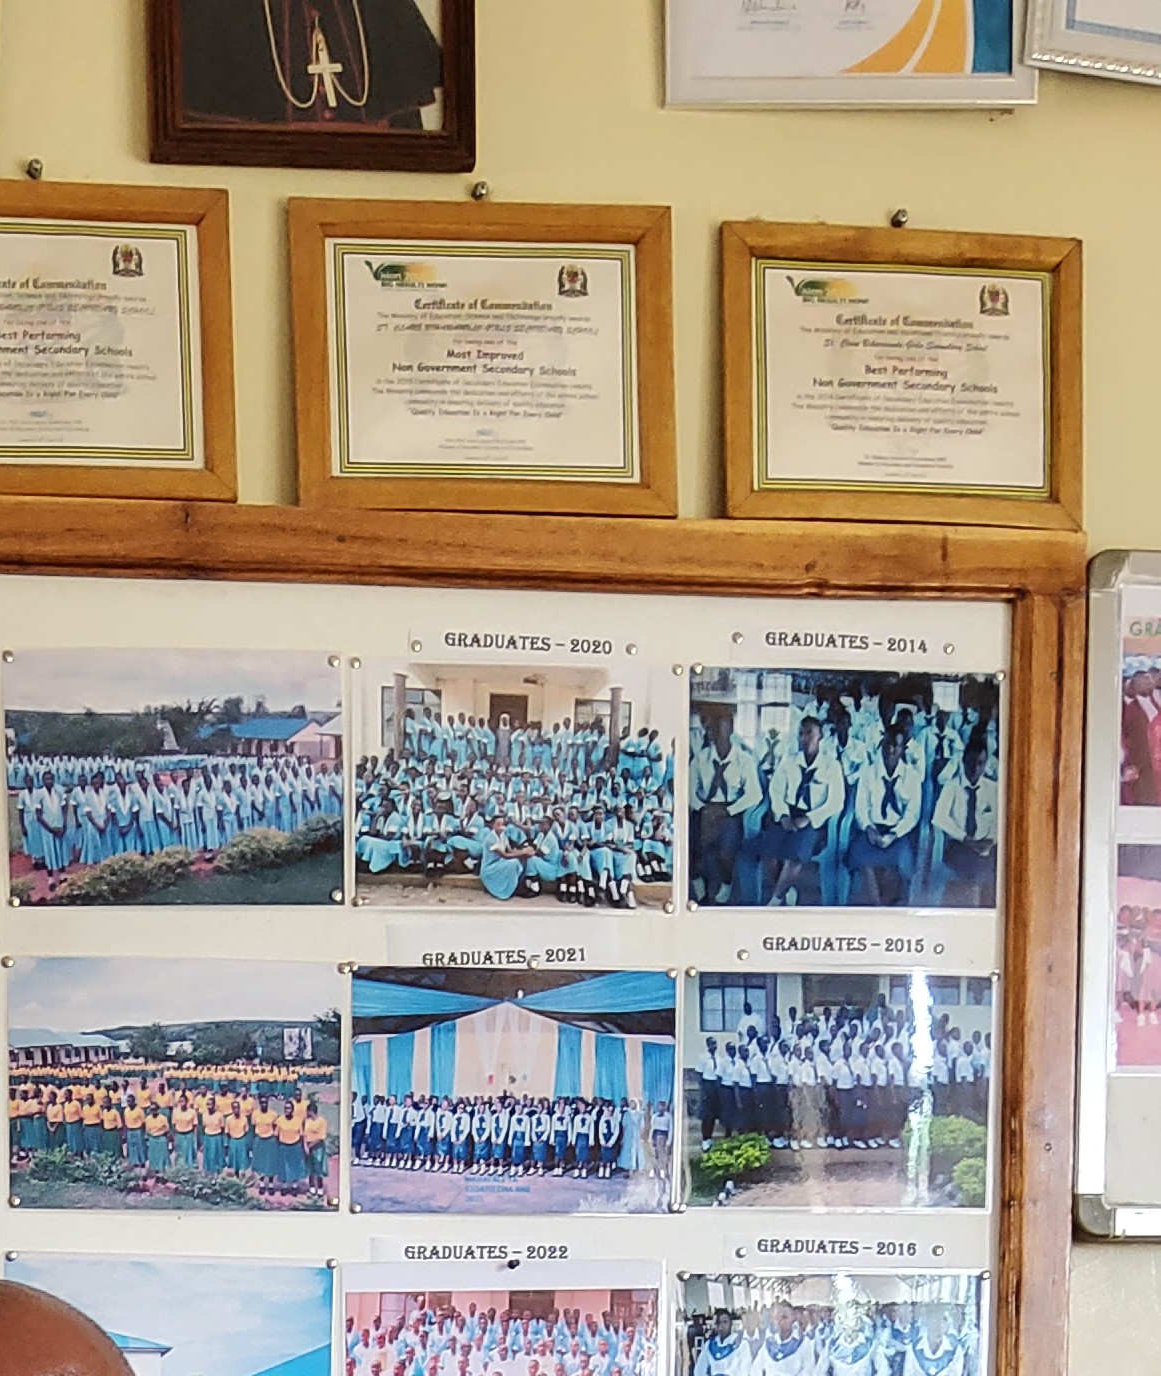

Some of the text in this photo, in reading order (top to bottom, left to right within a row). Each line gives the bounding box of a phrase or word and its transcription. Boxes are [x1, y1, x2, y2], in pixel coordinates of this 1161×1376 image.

[23, 330, 81, 342] Performing
[35, 345, 89, 356] Secondary
[94, 346, 133, 357] Schools
[447, 350, 524, 362] Most Improved
[392, 363, 576, 376] Non Government Secondary Schools
[865, 365, 947, 379] Best Performing
[813, 379, 997, 393] Non Government Secondary Schools
[444, 632, 613, 654] GRADUATES 2020
[765, 632, 927, 653] GRADUATES 2014
[763, 937, 924, 953] GRADUATES 2015
[422, 948, 586, 966] GRADUATES 2021
[404, 1245, 568, 1260] GRADUATES 2022
[757, 1239, 917, 1256] GRADUATES 2016
